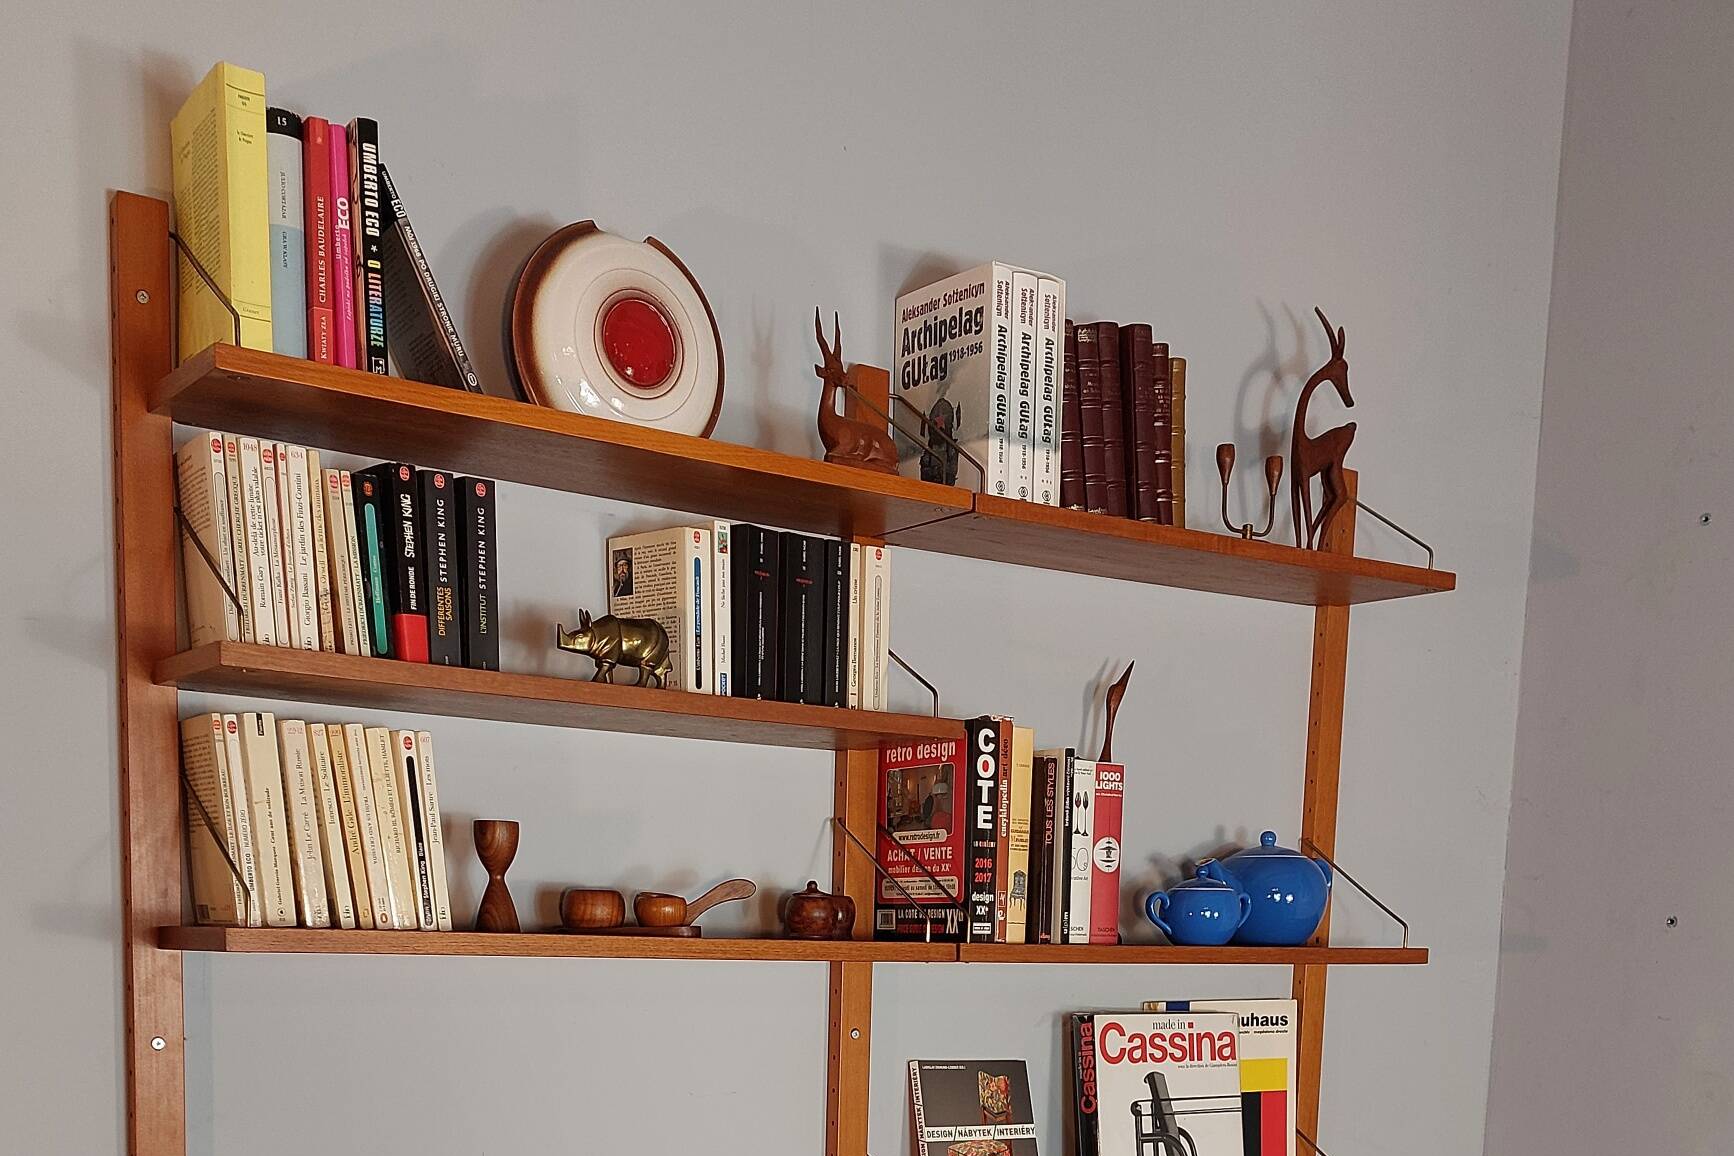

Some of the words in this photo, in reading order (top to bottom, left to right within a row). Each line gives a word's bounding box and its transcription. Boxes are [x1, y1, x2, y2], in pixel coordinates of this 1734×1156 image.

[277, 116, 287, 126] 15
[362, 142, 379, 209] UMBERTO
[382, 170, 397, 200] UMBERTO
[391, 199, 407, 218] ECO
[317, 195, 325, 257] BAUDELAIRE
[337, 197, 350, 231] ECO
[366, 211, 380, 237] ECO
[367, 259, 381, 269] O
[318, 259, 326, 303] CHARLES
[367, 273, 384, 348] LITERATURZE
[424, 271, 440, 302] DRUGIEJ
[437, 302, 453, 334] STRONIE
[451, 334, 465, 357] MURU
[902, 297, 941, 324] Aleksander
[901, 305, 985, 358] Archipelag
[949, 341, 983, 363] 1918-1956
[995, 324, 1008, 390] Archipelag
[1019, 331, 1032, 397] Archipelag
[1043, 337, 1055, 401] Archipelag
[294, 473, 304, 519] Finzi-Contini
[400, 493, 412, 518] KING
[436, 499, 446, 528] KING
[477, 507, 485, 536] KING
[299, 534, 308, 555] jardin
[350, 535, 358, 560] MISSION
[402, 520, 415, 558] STEPHEN
[300, 555, 308, 566] Le
[437, 532, 448, 583] STEPHEN
[478, 541, 487, 589] STEPHEN
[257, 566, 265, 582] Gary
[301, 573, 309, 598] Bassani
[408, 566, 416, 589] RONDE
[258, 583, 267, 608] Romain
[410, 590, 416, 599] DE
[445, 587, 453, 621] SAISONS
[303, 600, 312, 626] Giorgio
[479, 594, 488, 634] L'INSTITUT
[887, 746, 913, 763] retro
[917, 741, 956, 762] design
[319, 751, 329, 780] Solitaire
[337, 750, 351, 803] L'immoraliste
[1099, 771, 1121, 781] 1000
[976, 728, 996, 829] COTE
[1047, 762, 1055, 798] STYLES
[1095, 780, 1123, 791] LIGHTS
[300, 795, 307, 806] La
[327, 797, 336, 825] Ionesco
[999, 780, 1009, 837] encyklopedia
[1046, 800, 1054, 818] LES
[345, 809, 356, 829] Gide
[430, 812, 440, 844] Jean-Paul
[1045, 819, 1053, 844] TOUS
[306, 843, 316, 861] John
[349, 830, 360, 855] André
[923, 847, 953, 860] VENTE
[888, 865, 910, 874] mobilier
[975, 858, 992, 868] 2016
[247, 866, 255, 891] UMBERTO
[421, 875, 429, 899] Stephen
[974, 872, 992, 883] 2017
[971, 891, 994, 904] design
[897, 909, 904, 919] LA
[905, 908, 918, 919] COTE
[1152, 1019, 1176, 1031] made
[1177, 1019, 1186, 1030] in
[1240, 1012, 1289, 1027] uhaus
[1099, 1021, 1238, 1065] Cassina
[1079, 1022, 1097, 1114] Cassina
[926, 1129, 953, 1139] DESIGN
[957, 1126, 992, 1138] NÁBYTEK
[996, 1125, 1035, 1136] INTERIÉRY
